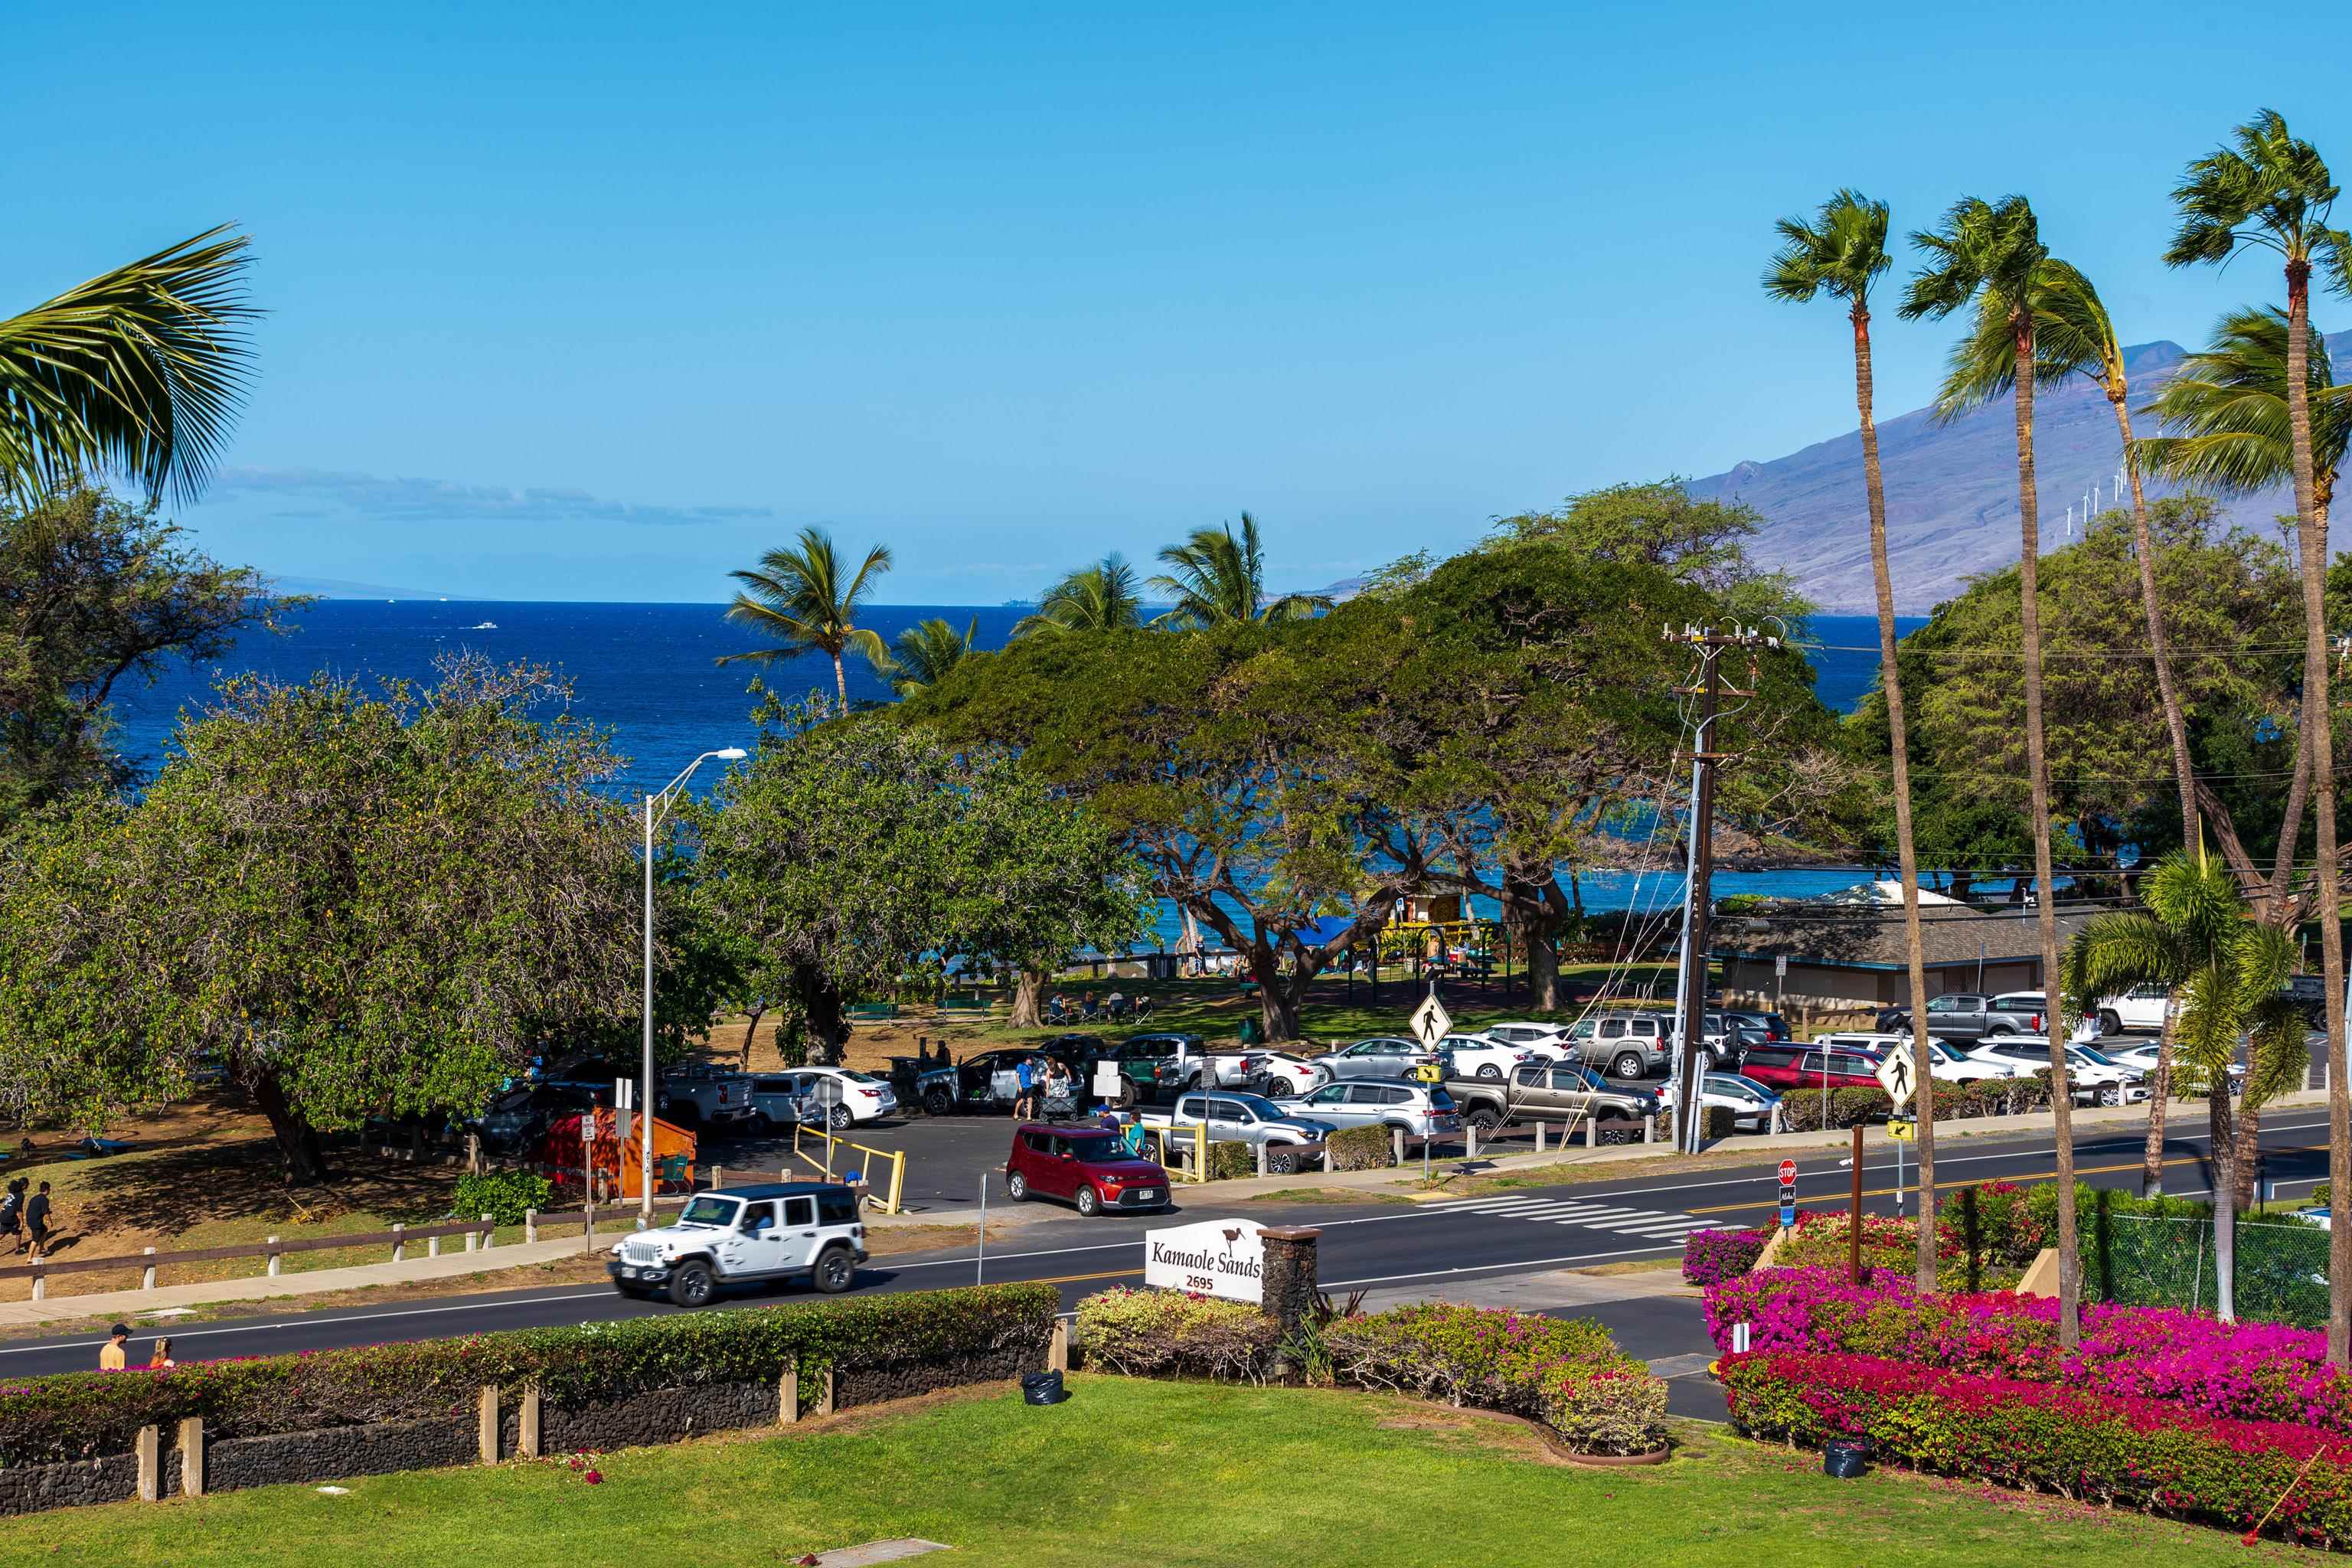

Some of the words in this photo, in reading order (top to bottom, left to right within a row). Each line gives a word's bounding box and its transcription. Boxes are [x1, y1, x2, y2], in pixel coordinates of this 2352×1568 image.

[1779, 1168, 1795, 1178] STOP
[1152, 1242, 1214, 1271] Kamaole
[1217, 1252, 1260, 1278] Sands
[1187, 1275, 1213, 1289] 2695
